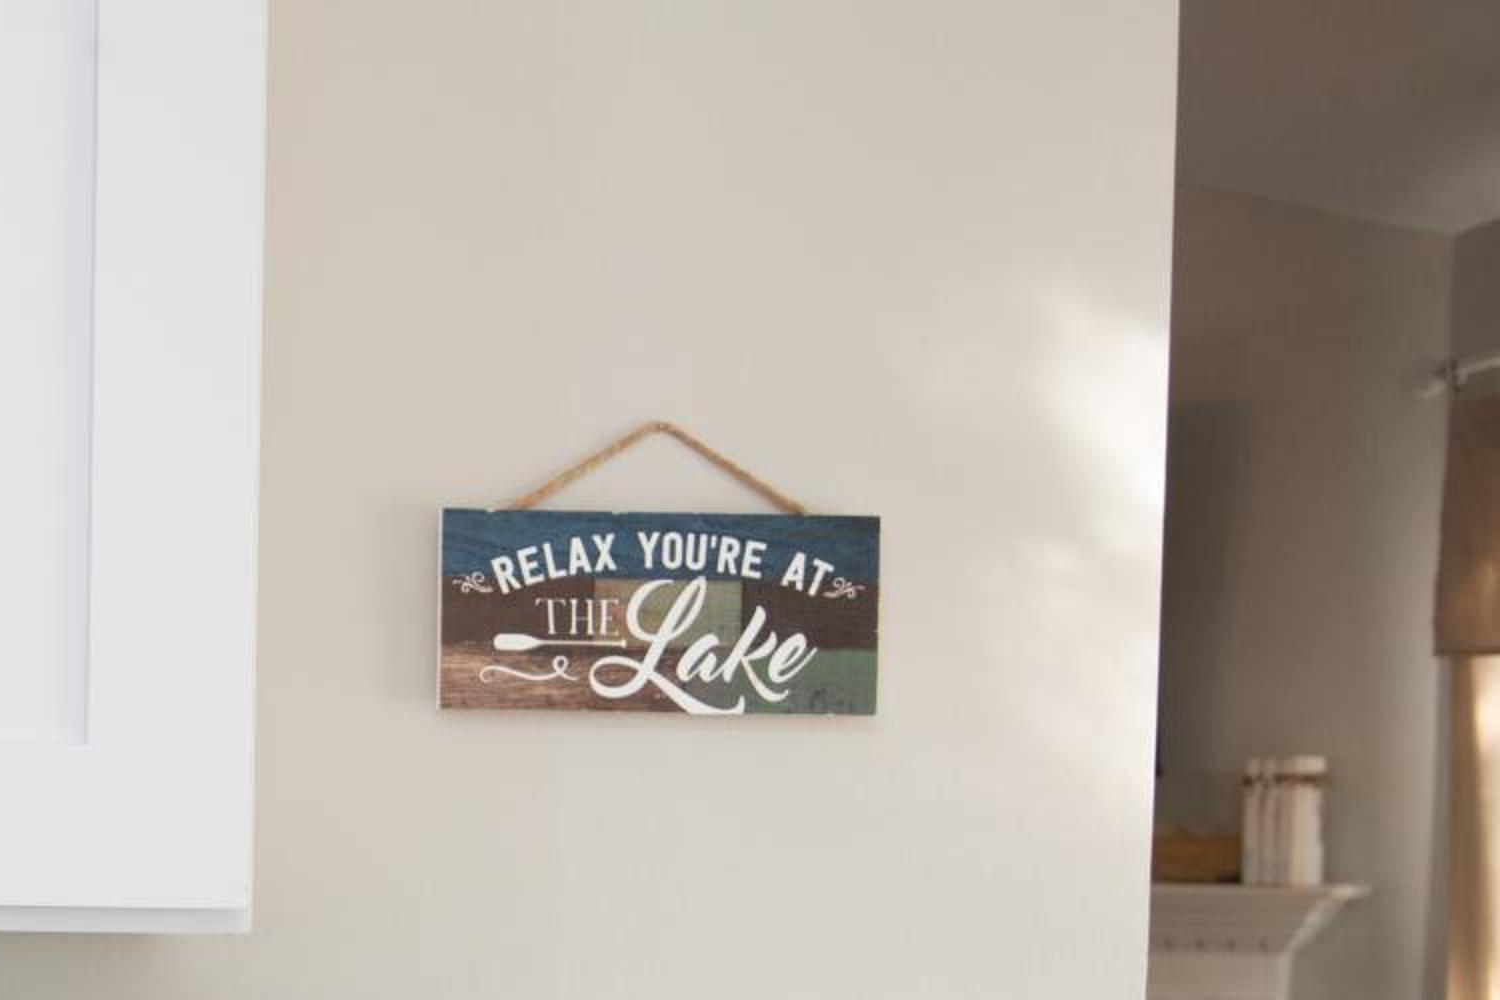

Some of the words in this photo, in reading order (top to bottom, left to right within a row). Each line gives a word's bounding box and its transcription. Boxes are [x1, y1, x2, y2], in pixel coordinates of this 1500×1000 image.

[490, 533, 617, 594] RELAX
[637, 531, 768, 579] YOU'RE
[780, 551, 835, 597] AT
[535, 597, 621, 637] THE
[589, 575, 818, 715] Lake
